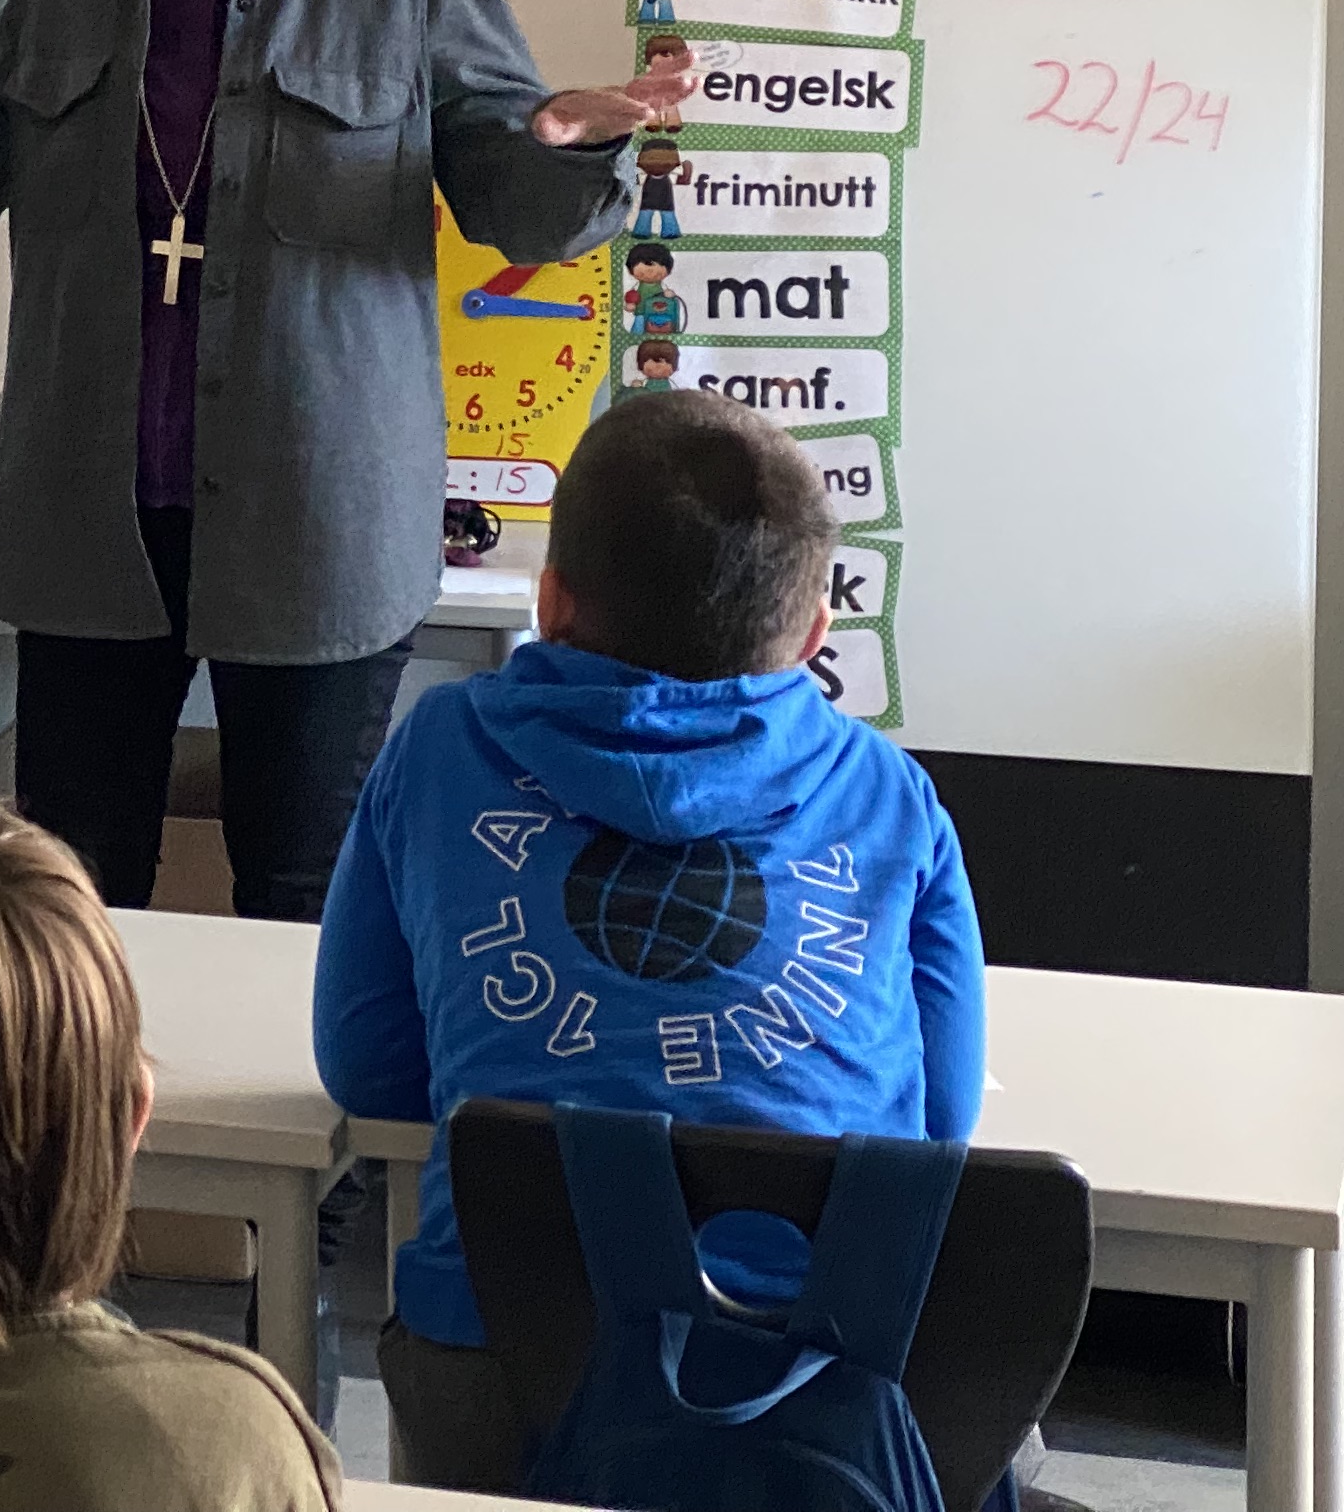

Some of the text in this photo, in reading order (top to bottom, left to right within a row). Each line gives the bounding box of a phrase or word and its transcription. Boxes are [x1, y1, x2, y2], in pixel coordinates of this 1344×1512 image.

[703, 69, 896, 113] engelsk
[1027, 59, 1230, 165] 22/24
[694, 175, 877, 208] friminutt
[706, 264, 850, 320] mat
[455, 361, 496, 378] edx
[555, 345, 575, 372] 4
[465, 394, 484, 421] 6
[516, 379, 536, 407] 5
[823, 465, 872, 497] ng
[824, 562, 866, 612] k
